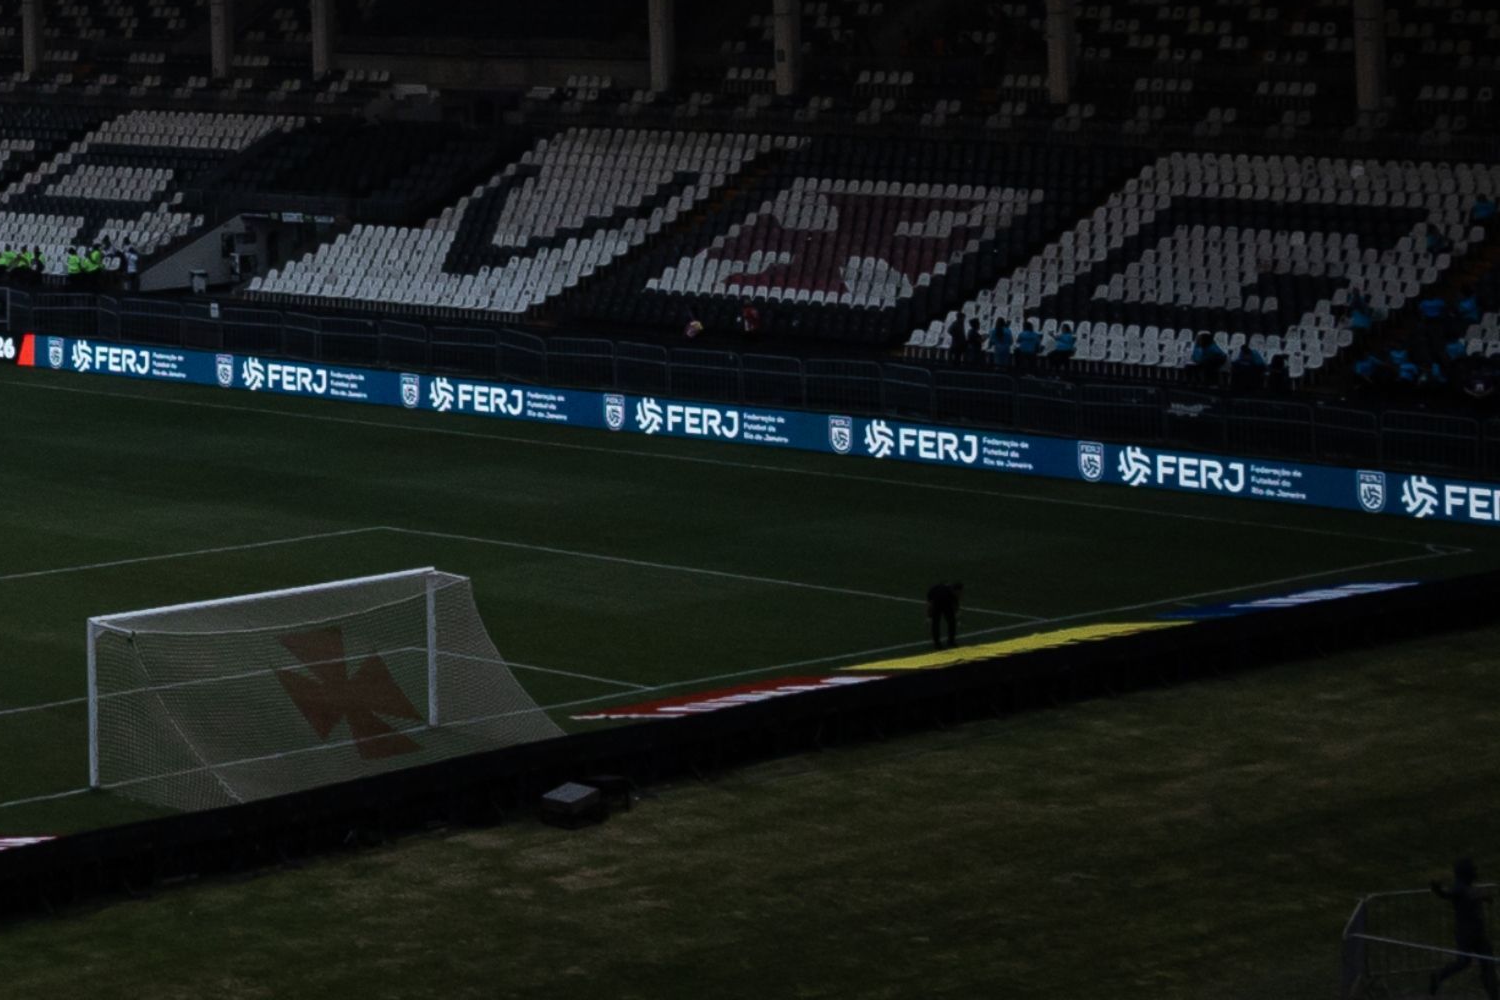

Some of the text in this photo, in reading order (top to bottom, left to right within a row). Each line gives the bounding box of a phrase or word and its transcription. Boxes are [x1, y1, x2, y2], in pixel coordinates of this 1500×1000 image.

[95, 346, 149, 375] FERJ
[267, 363, 327, 394] FERJ
[458, 384, 523, 416] FERJ
[667, 405, 739, 439] FERJ
[900, 428, 978, 464] FERJ
[1157, 454, 1245, 493] FERJ
